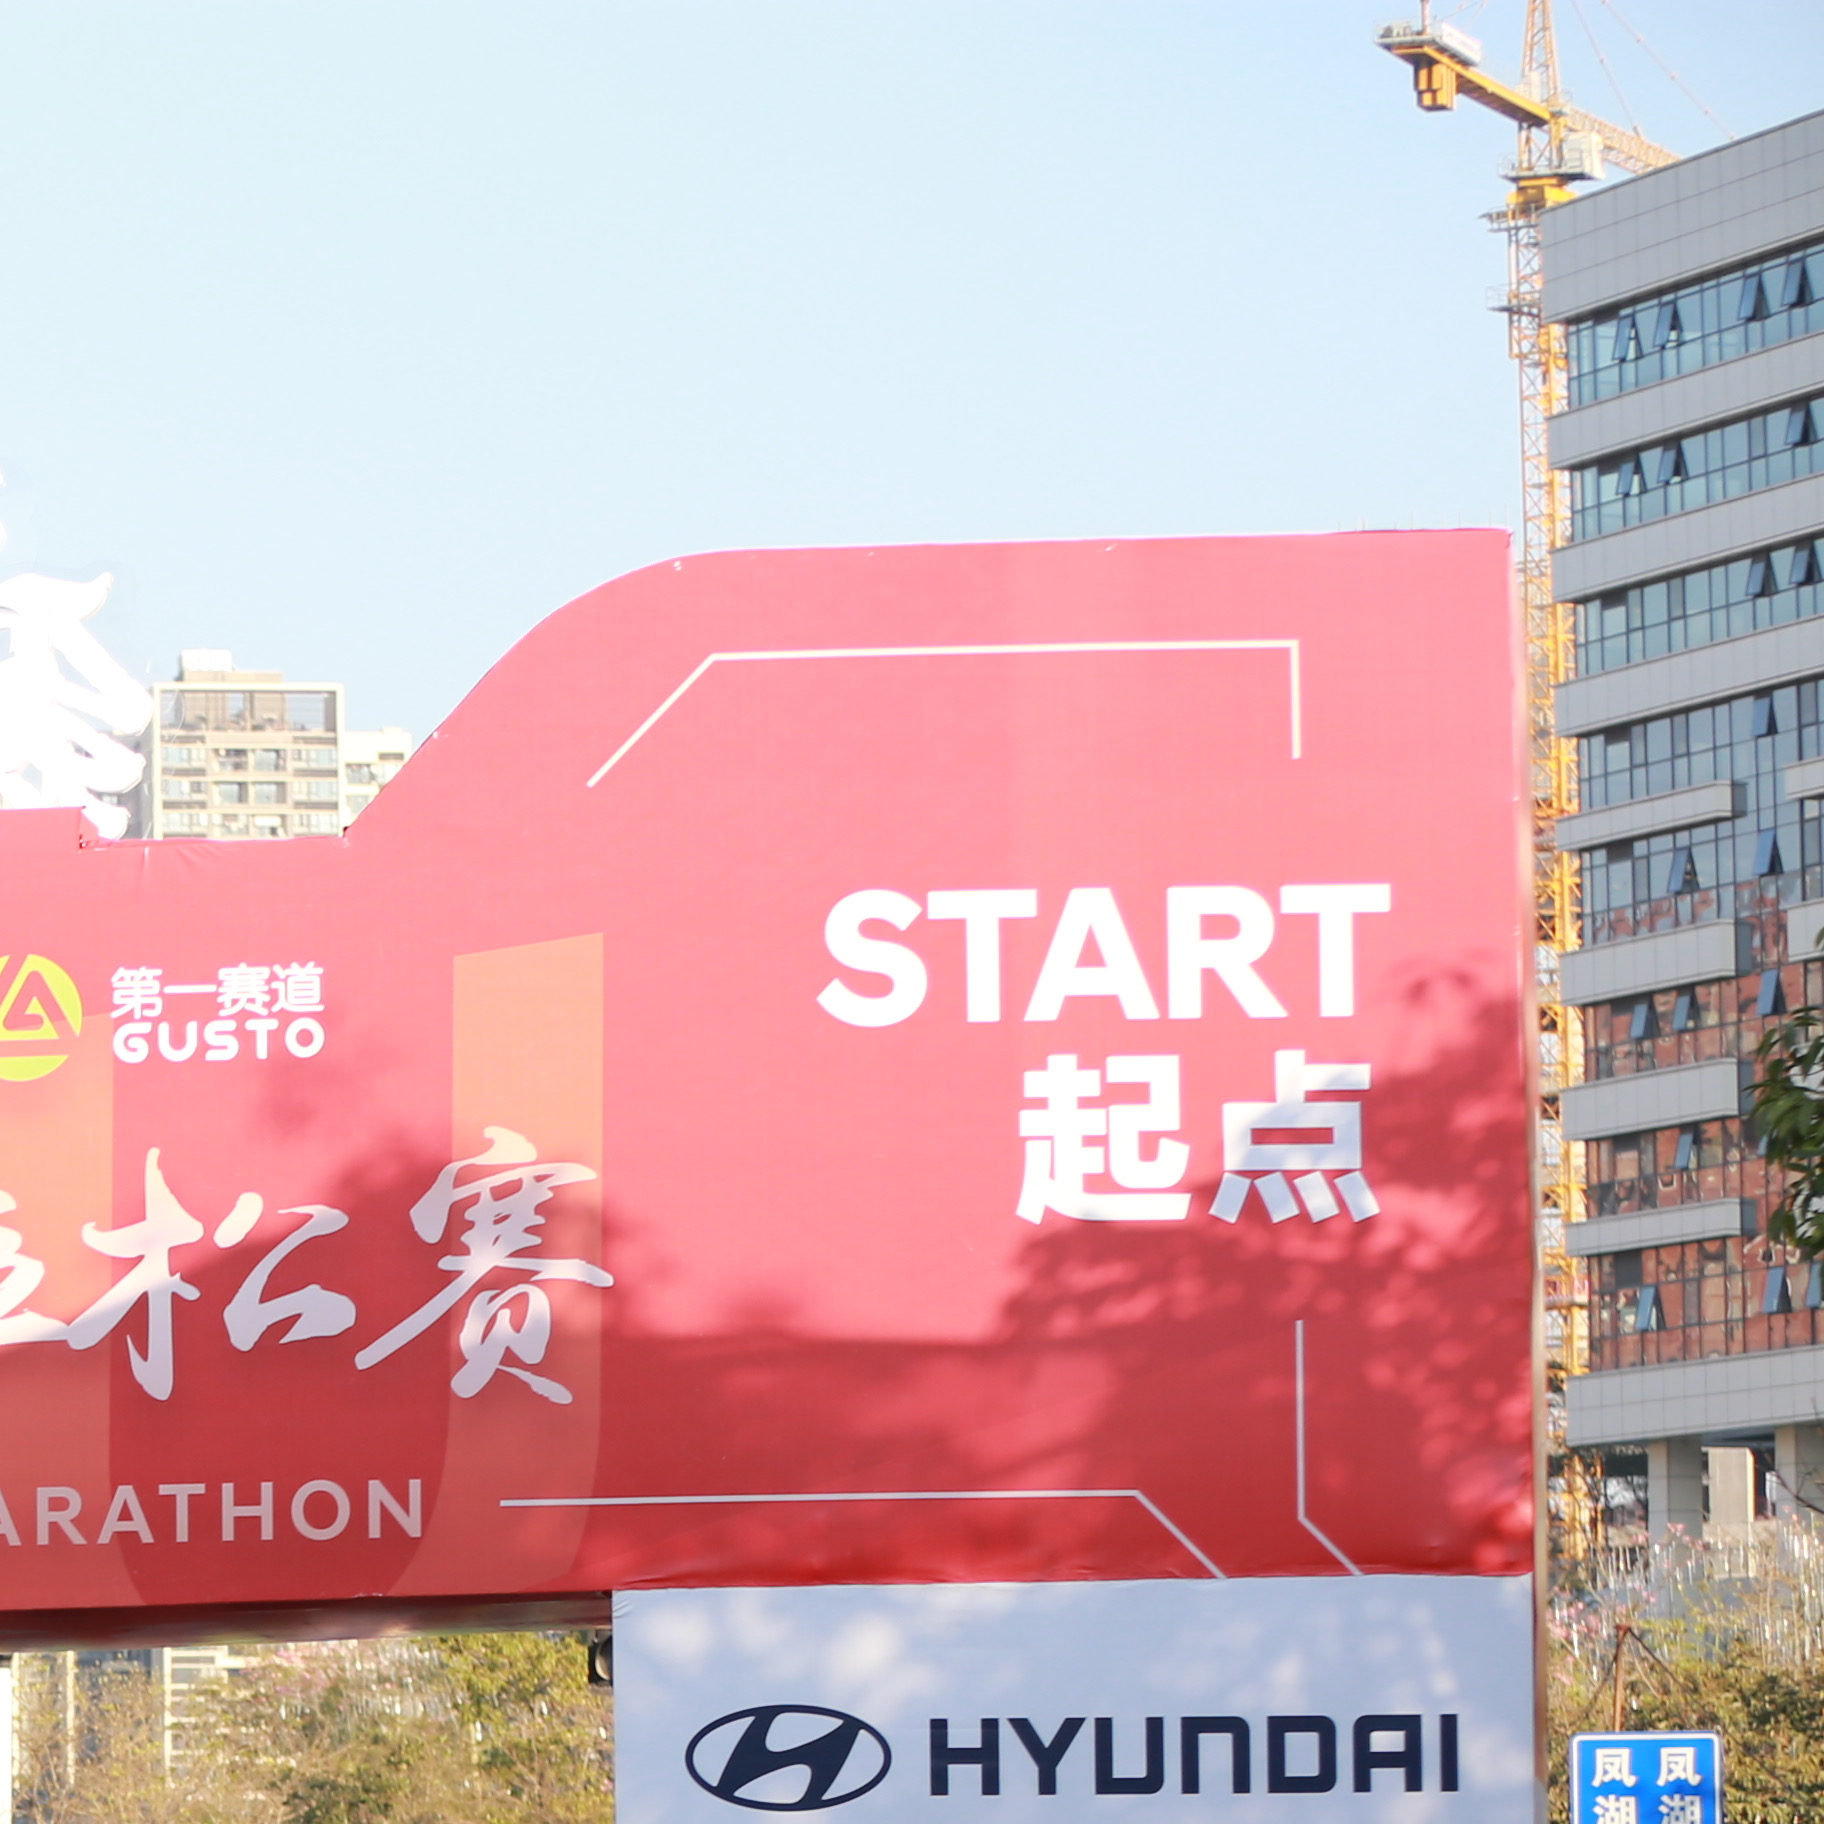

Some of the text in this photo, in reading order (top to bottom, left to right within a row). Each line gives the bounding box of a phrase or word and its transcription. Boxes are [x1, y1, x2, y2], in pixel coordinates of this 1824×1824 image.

[110, 962, 325, 1019] 第一赛道
[816, 883, 1391, 1028] START
[112, 1018, 326, 1064] GUSTO
[1016, 1049, 1380, 1225] 起点
[929, 1713, 1460, 1796] HYUNDAI
